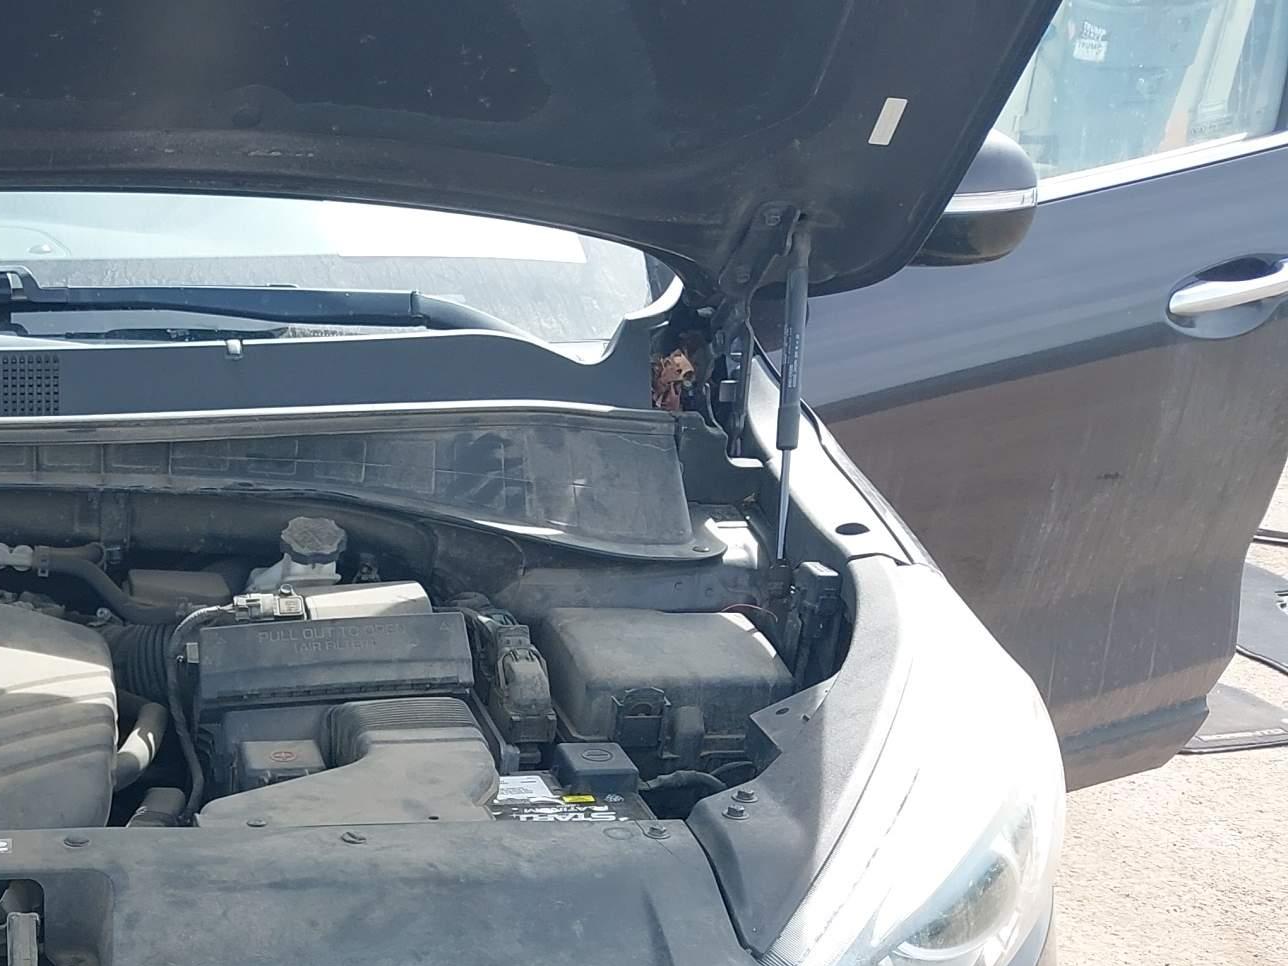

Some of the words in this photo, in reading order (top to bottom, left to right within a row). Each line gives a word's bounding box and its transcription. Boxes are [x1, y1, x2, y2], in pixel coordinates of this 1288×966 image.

[258, 630, 298, 643] PULL
[303, 626, 336, 640] OUT
[339, 624, 360, 637] TO
